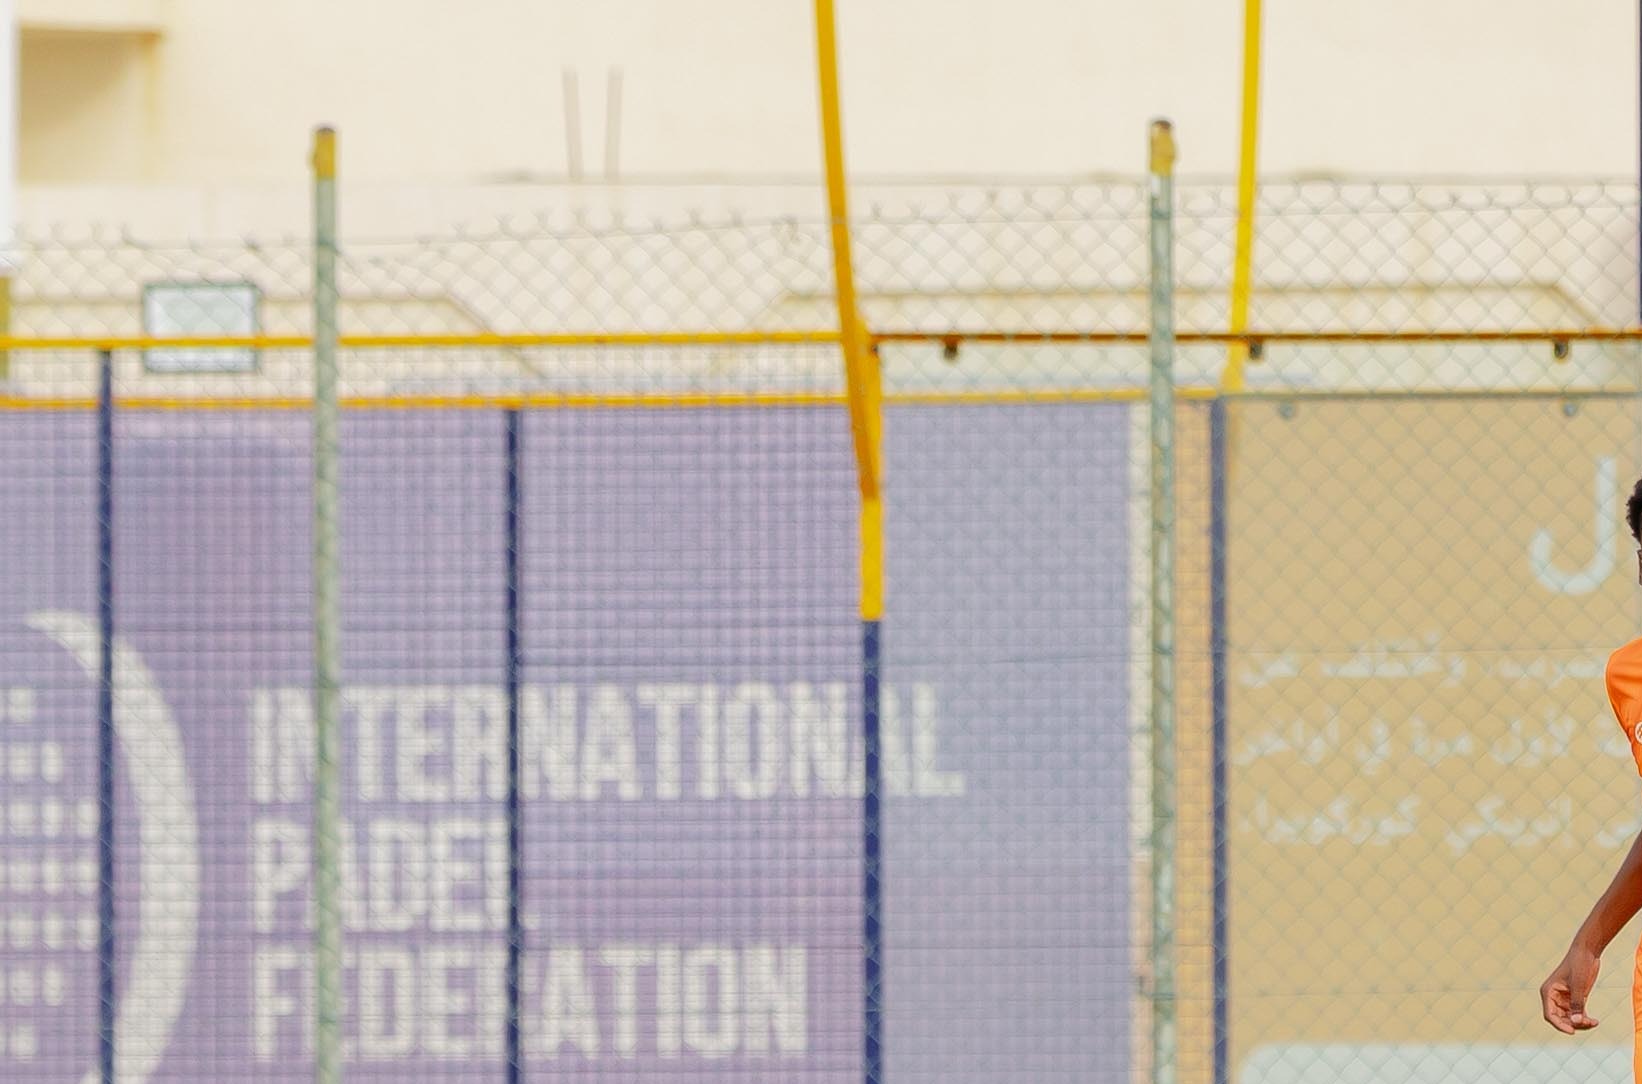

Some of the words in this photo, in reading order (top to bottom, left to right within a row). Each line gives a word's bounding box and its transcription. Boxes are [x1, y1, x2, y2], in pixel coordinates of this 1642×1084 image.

[251, 682, 966, 802] INTERNATIONAL
[251, 820, 540, 931] PADEL
[251, 942, 808, 1062] FEDERATION
